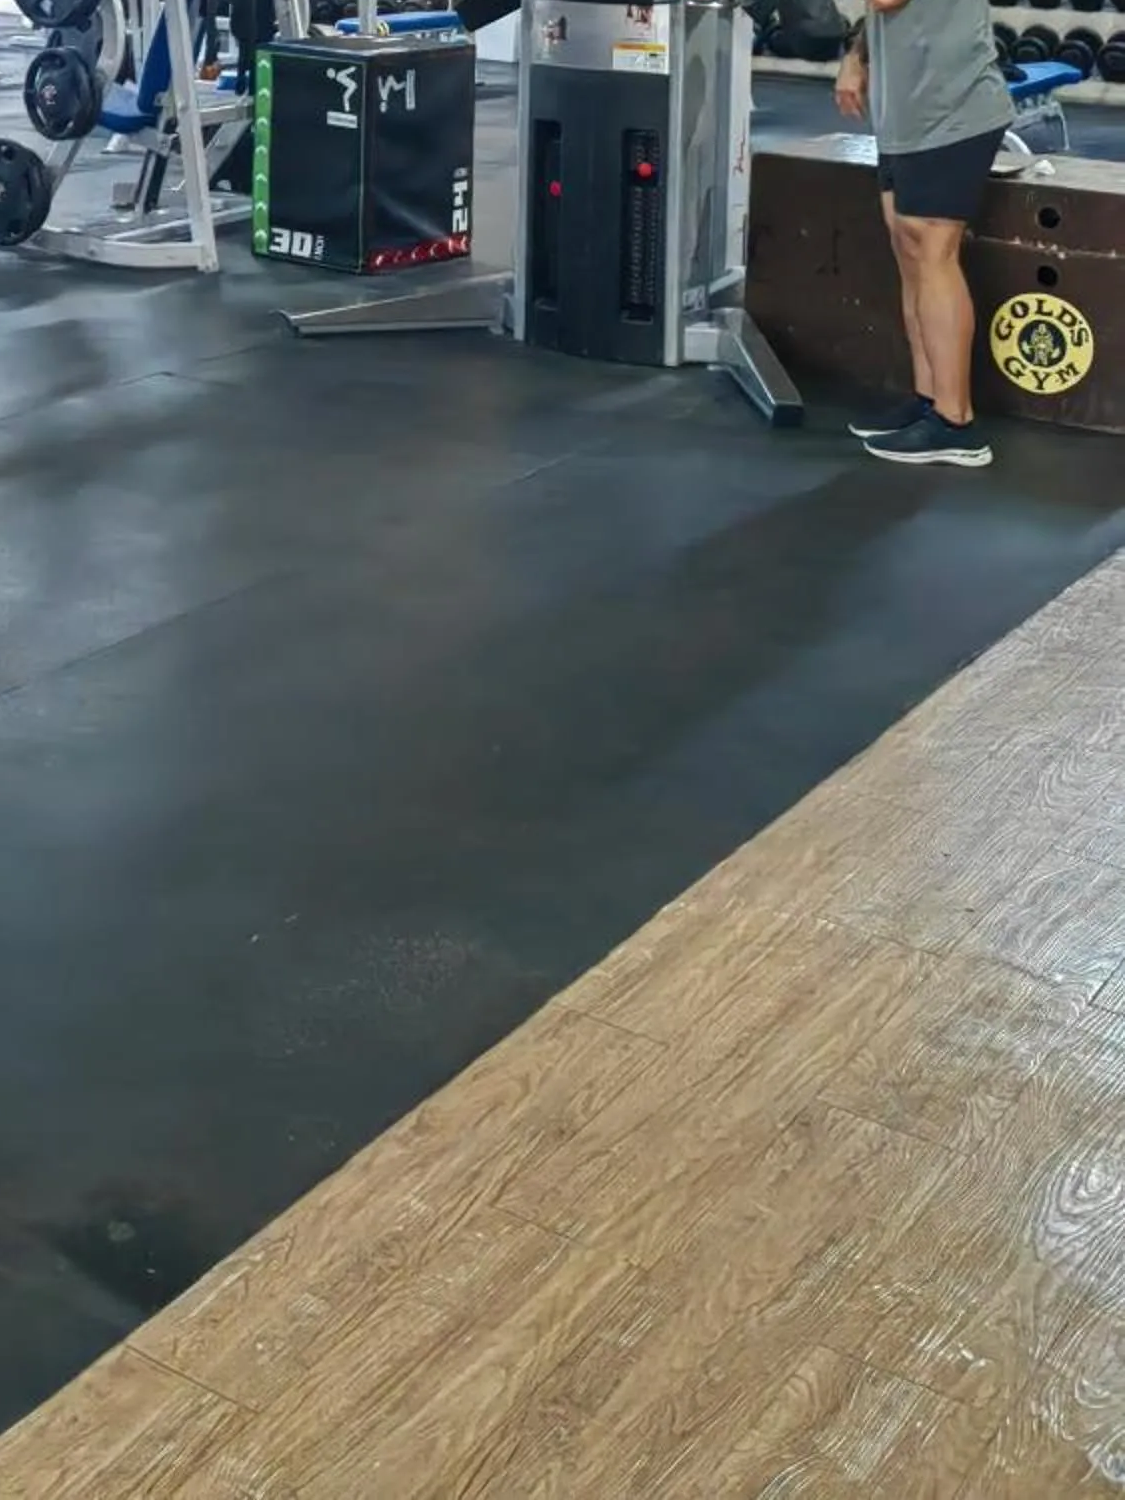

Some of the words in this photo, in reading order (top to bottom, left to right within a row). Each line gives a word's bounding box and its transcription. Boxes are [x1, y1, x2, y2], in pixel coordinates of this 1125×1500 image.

[269, 227, 313, 258] 30
[994, 297, 1090, 347] GOLD'S
[1003, 355, 1080, 390] GYM
